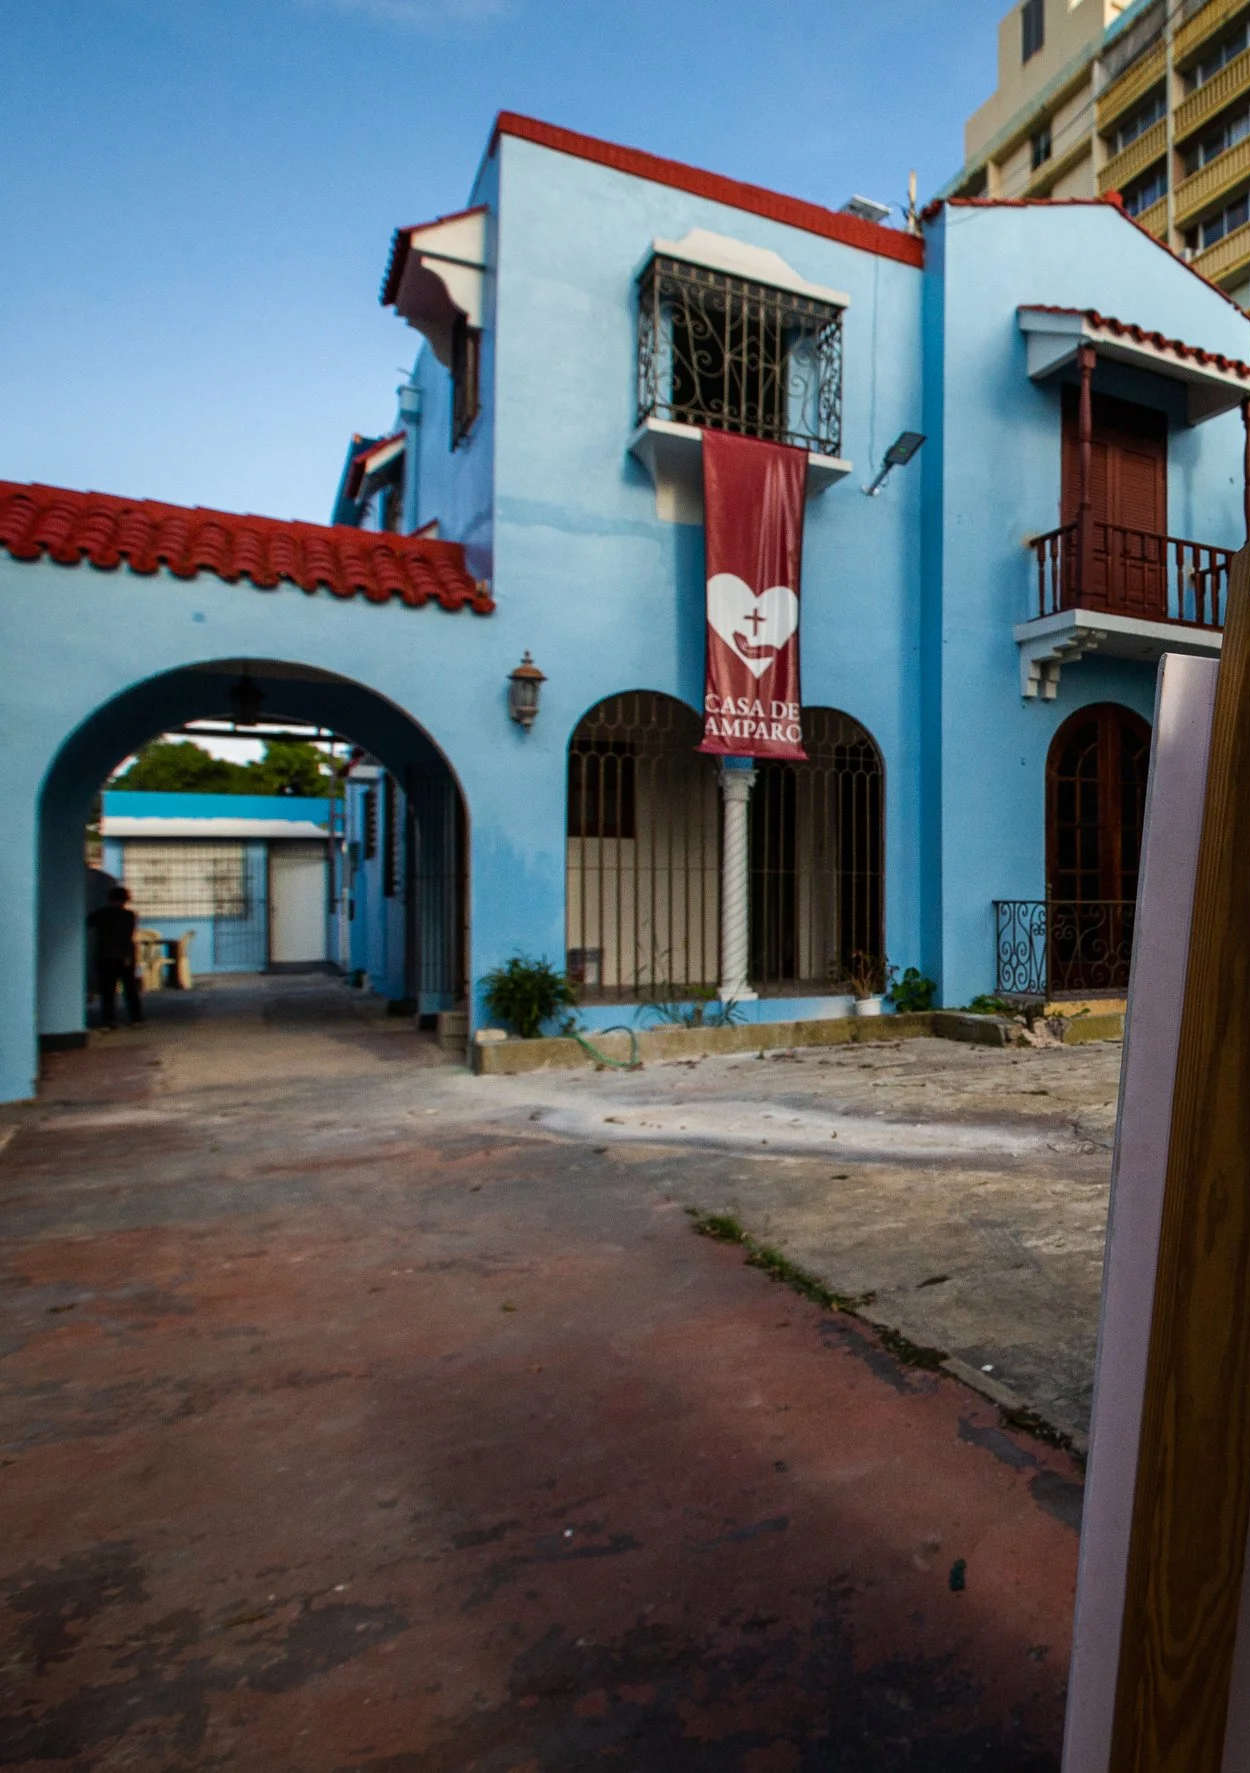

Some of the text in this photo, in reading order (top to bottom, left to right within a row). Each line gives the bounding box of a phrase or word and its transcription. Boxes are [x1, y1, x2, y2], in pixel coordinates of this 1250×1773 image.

[704, 693, 801, 721] CASA DE
[704, 715, 804, 744] AMPARO
